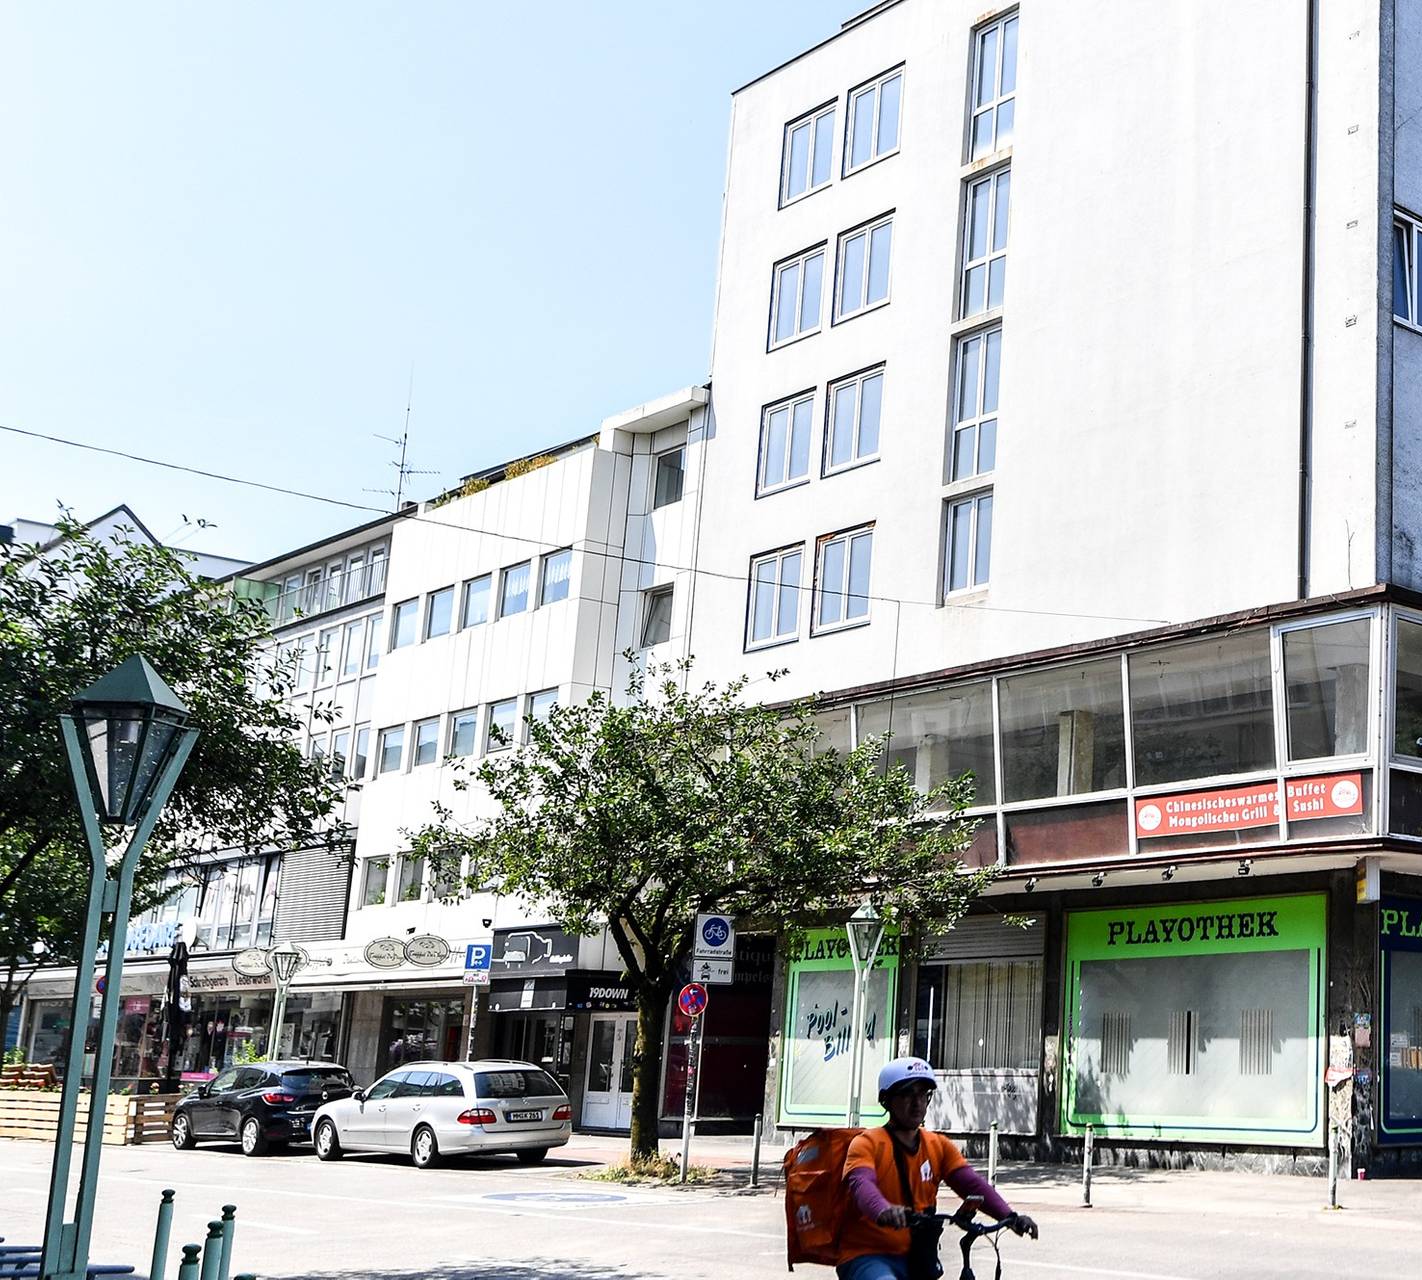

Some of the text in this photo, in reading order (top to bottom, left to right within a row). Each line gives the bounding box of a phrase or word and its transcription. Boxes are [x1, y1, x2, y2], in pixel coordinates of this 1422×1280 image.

[1287, 783, 1326, 798] Buffet
[1241, 805, 1267, 820] Grill
[1293, 798, 1324, 812] Sushi
[1107, 911, 1279, 946] PLAYOTHEK
[470, 946, 486, 967] P
[589, 987, 628, 999] 19DOWN
